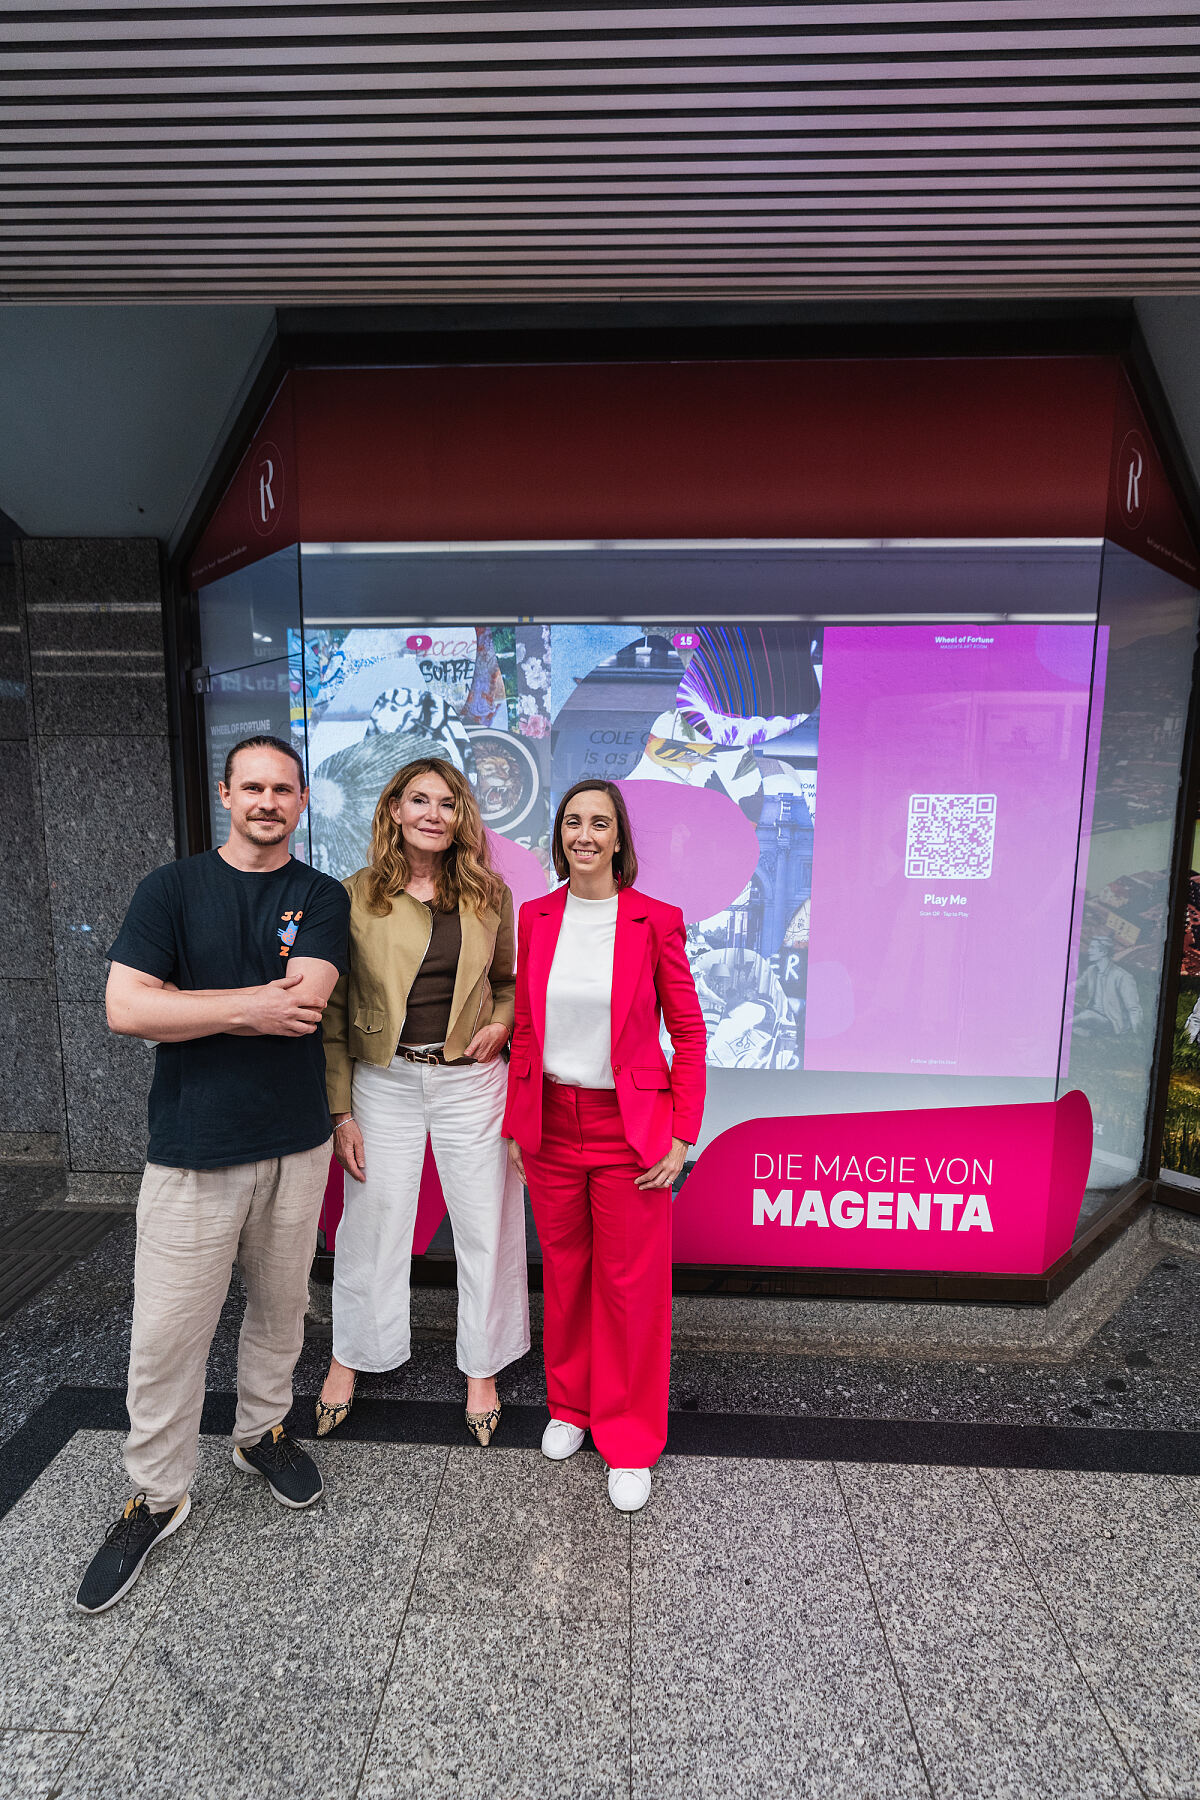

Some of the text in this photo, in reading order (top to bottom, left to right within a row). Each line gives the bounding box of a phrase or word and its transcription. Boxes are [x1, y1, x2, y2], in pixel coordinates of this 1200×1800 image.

[415, 637, 423, 647] 9
[679, 636, 693, 646] 15
[934, 636, 958, 644] Wheel
[967, 636, 994, 644] Fortune
[210, 719, 271, 736] WHEEL OF FORTUNE
[584, 749, 599, 765] is
[604, 752, 629, 765] as
[923, 894, 968, 907] Play Me
[754, 1153, 993, 1186] DIE MAGIE VON
[752, 1188, 994, 1232] MAGENTA
